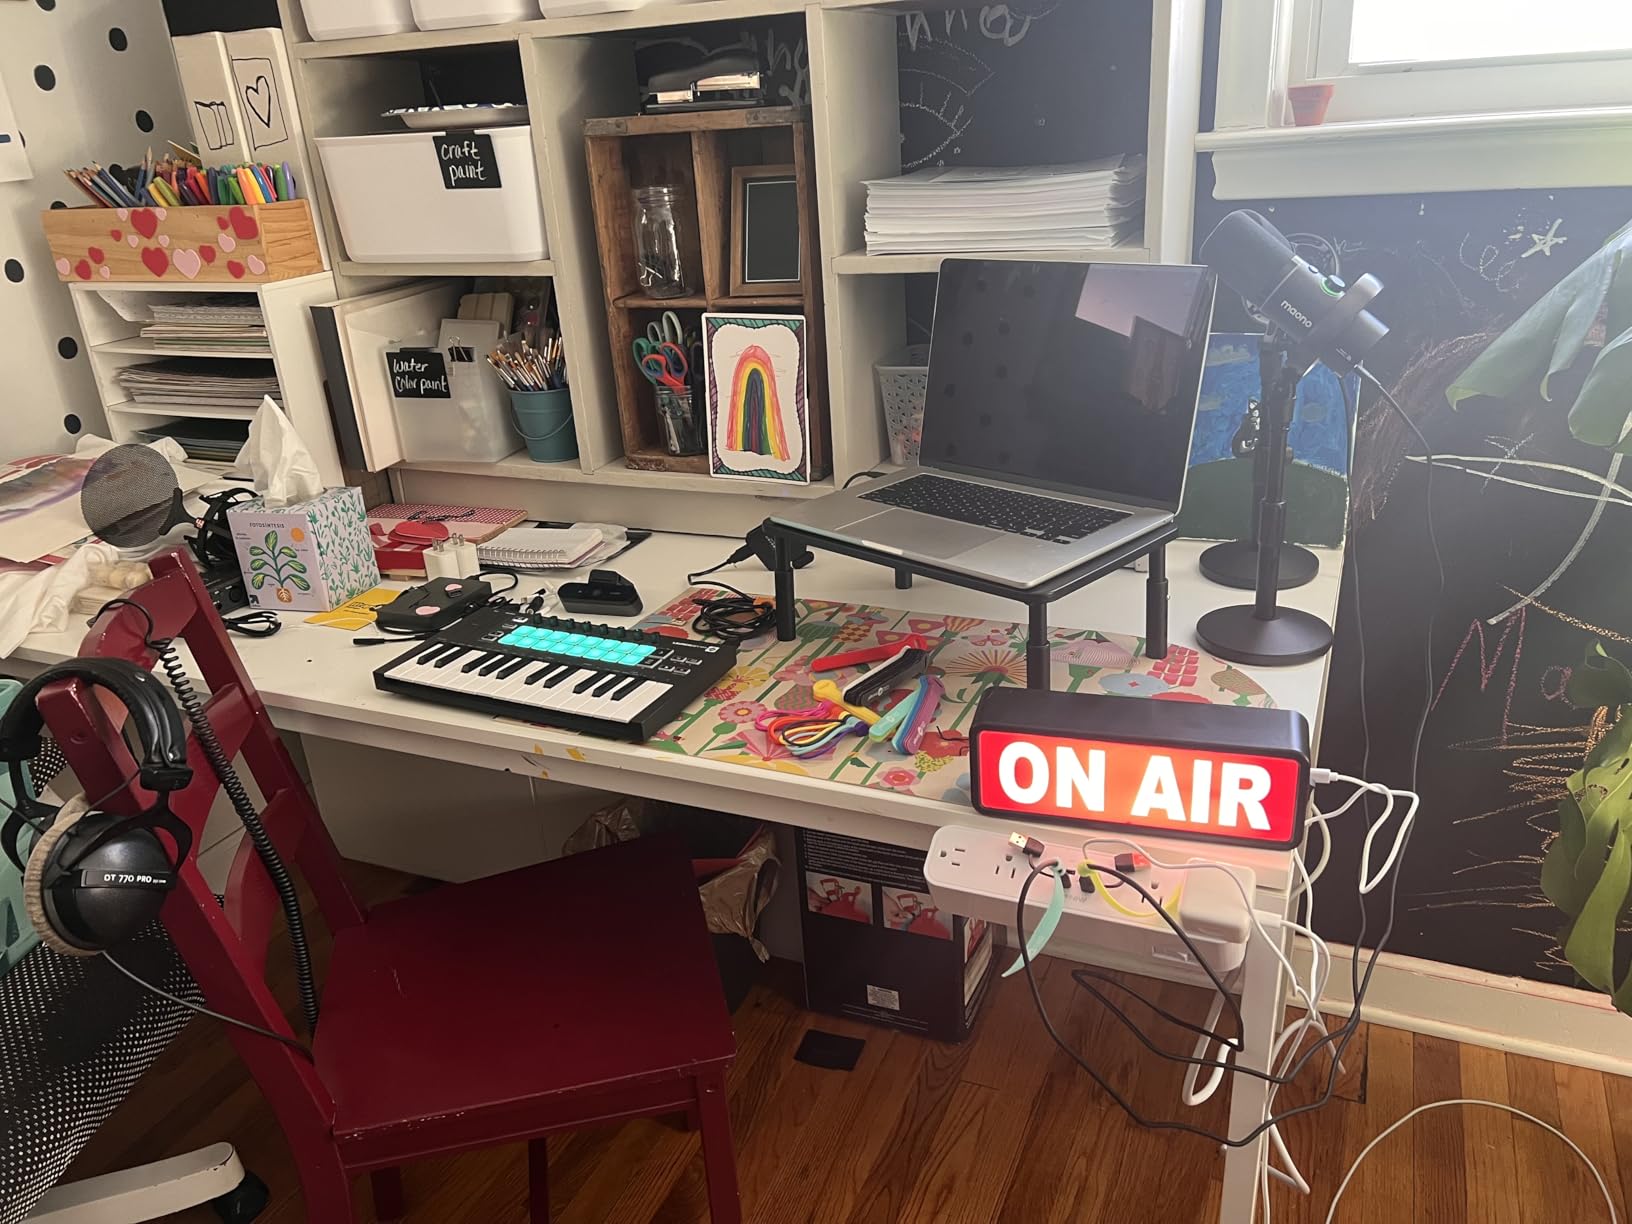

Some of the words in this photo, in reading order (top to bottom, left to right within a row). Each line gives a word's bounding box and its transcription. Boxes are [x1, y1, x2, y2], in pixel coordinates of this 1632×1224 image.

[449, 161, 487, 186] paint
[1280, 300, 1313, 328] maono
[420, 375, 448, 394] paint
[998, 741, 1106, 813] ON
[1129, 754, 1272, 832] AIR
[118, 875, 135, 884] 770
[136, 875, 153, 884] PRO
